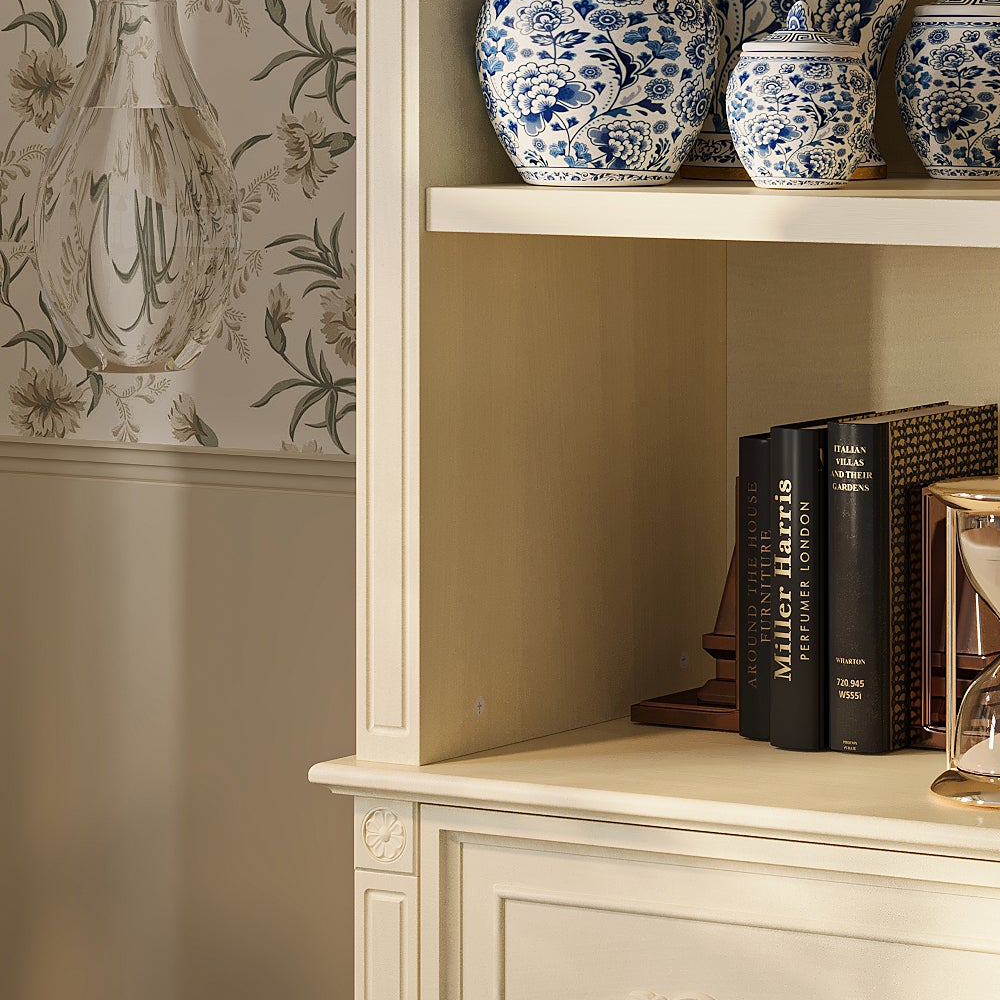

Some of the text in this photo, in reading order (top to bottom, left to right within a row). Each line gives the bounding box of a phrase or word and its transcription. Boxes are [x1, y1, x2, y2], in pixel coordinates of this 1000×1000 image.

[834, 444, 867, 454] ITALIAN
[836, 457, 865, 467] VILLAS
[845, 470, 873, 479] THEIR
[832, 482, 870, 492] GARDENS
[747, 481, 758, 689] AROUND THE HOUSE
[773, 479, 792, 682] Miller Harris
[800, 501, 810, 661] PERFUMER LONDON
[760, 529, 772, 643] FURNITURE
[835, 656, 866, 665] WHARTON
